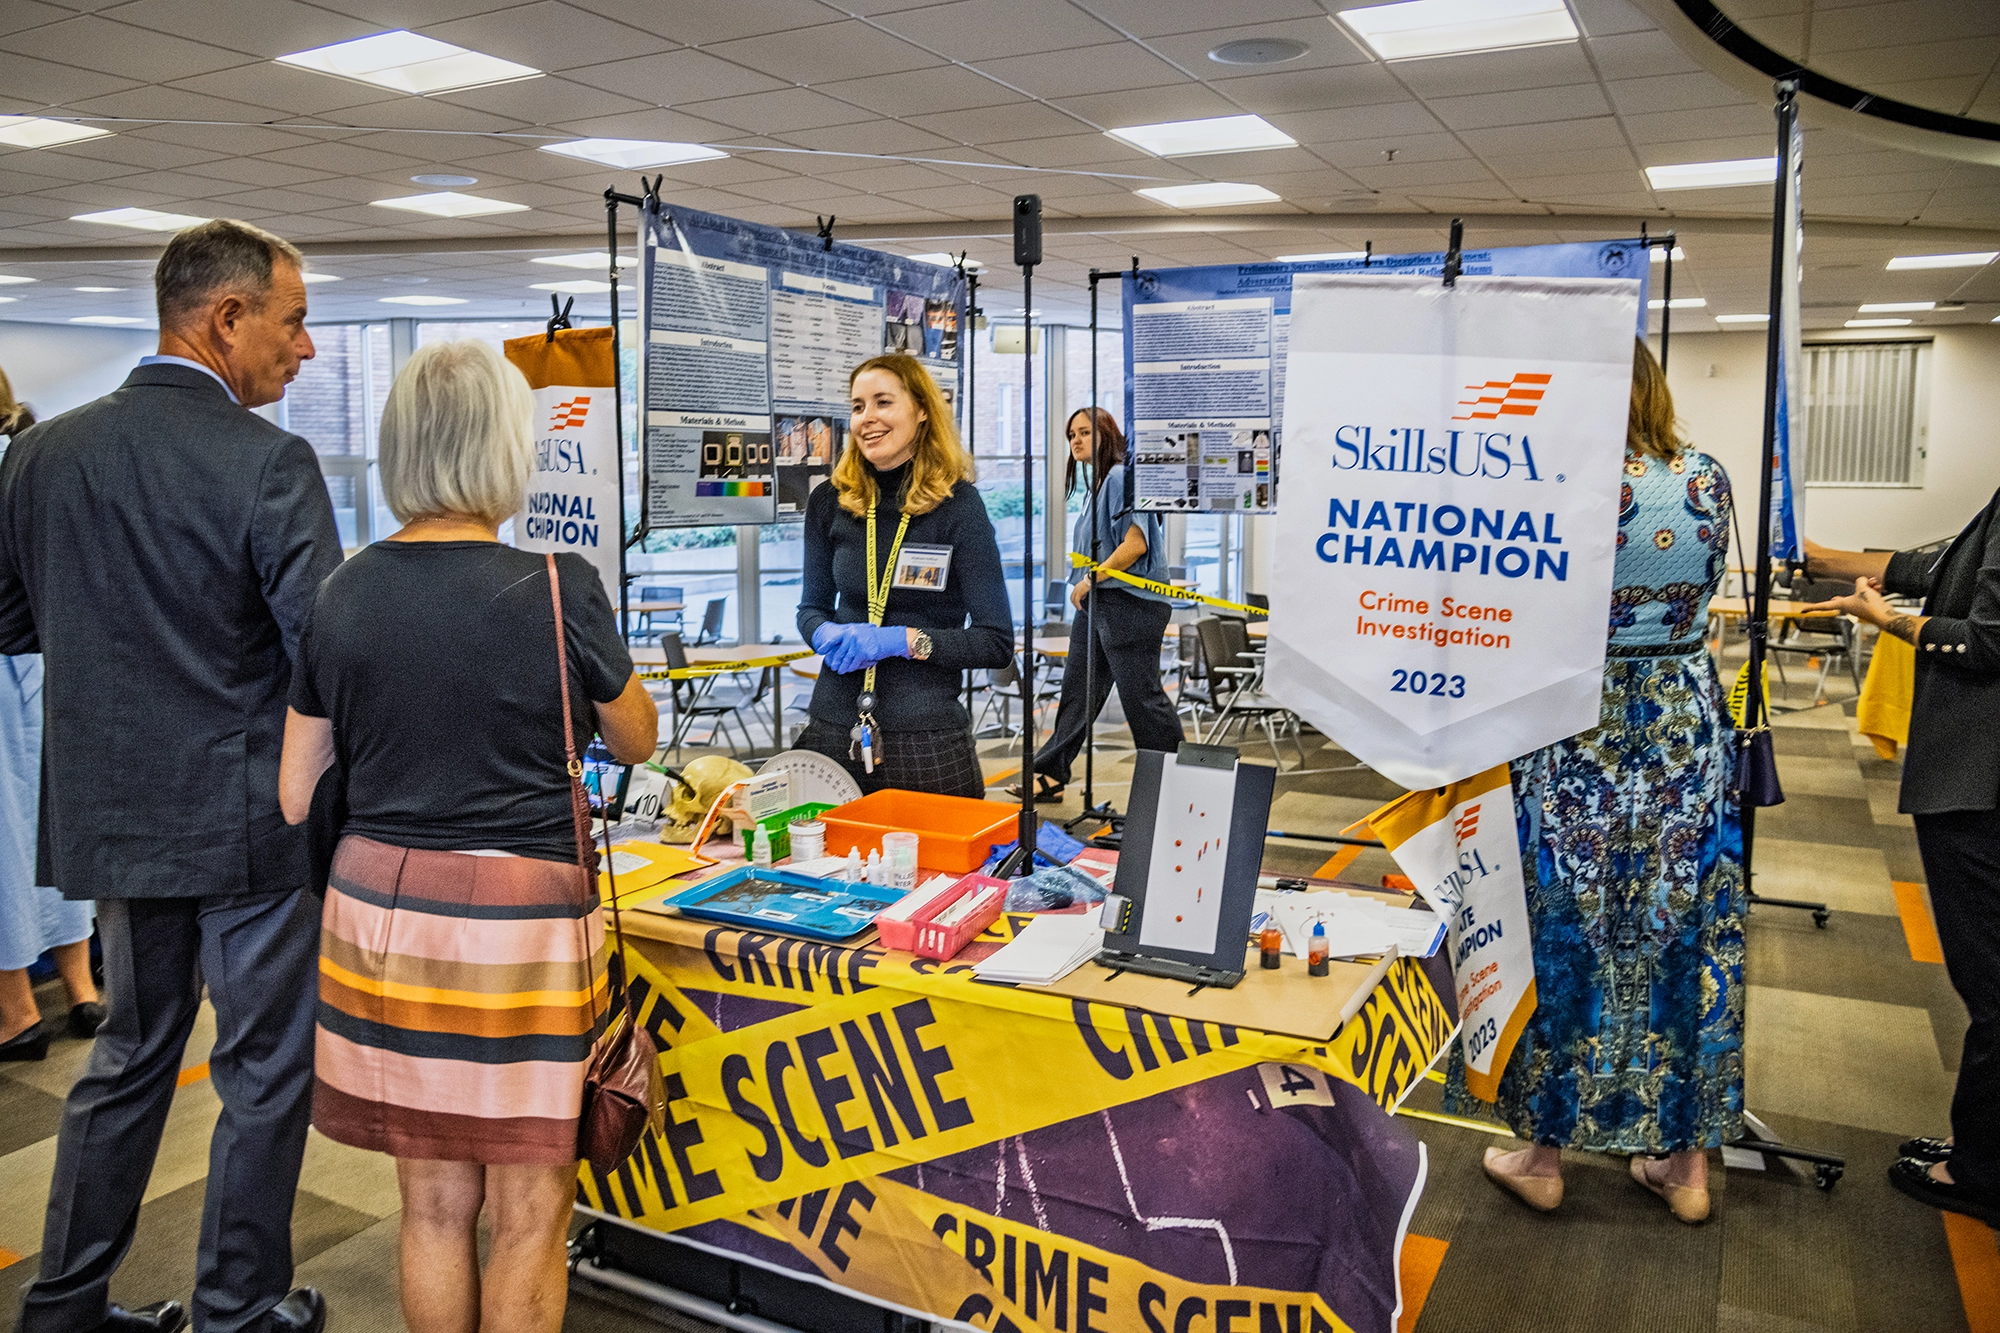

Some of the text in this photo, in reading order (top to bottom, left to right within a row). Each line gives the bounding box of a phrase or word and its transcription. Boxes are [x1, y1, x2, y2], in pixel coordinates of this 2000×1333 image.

[1347, 256, 1384, 270] Caera
[1180, 363, 1221, 371] Introduction
[680, 415, 714, 426] Materials
[1167, 421, 1198, 429] Materials
[1332, 424, 1544, 482] SkillsUSA
[1328, 498, 1563, 545] NATIONAL
[1315, 532, 1570, 582] CHAMPION
[1359, 590, 1513, 623] Crime Scene
[1356, 615, 1511, 649] Investigation
[1390, 668, 1466, 699] 2023
[642, 793, 659, 816] 10
[703, 929, 888, 994] CRIME
[721, 998, 975, 1183] SCENE
[1280, 1065, 1315, 1097] 4
